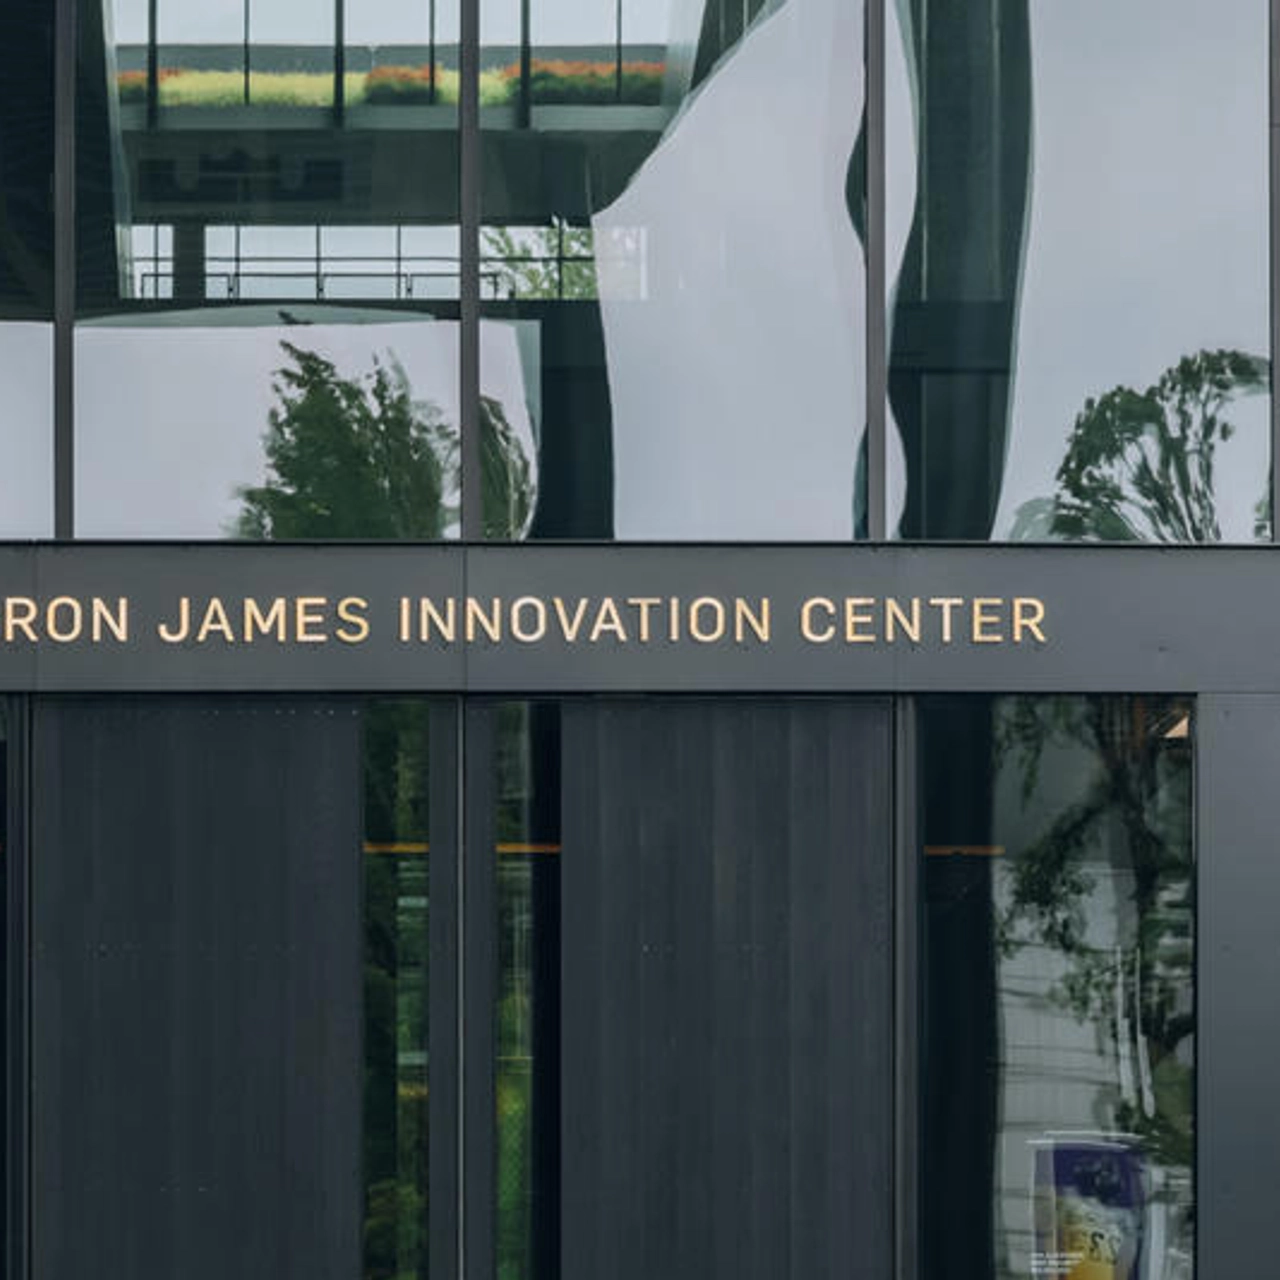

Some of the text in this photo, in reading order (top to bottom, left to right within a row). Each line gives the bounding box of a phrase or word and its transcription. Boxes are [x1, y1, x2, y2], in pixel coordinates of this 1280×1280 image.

[157, 596, 371, 643] JAMES
[400, 596, 772, 643] INNOVATION
[800, 596, 1047, 643] CENTER
